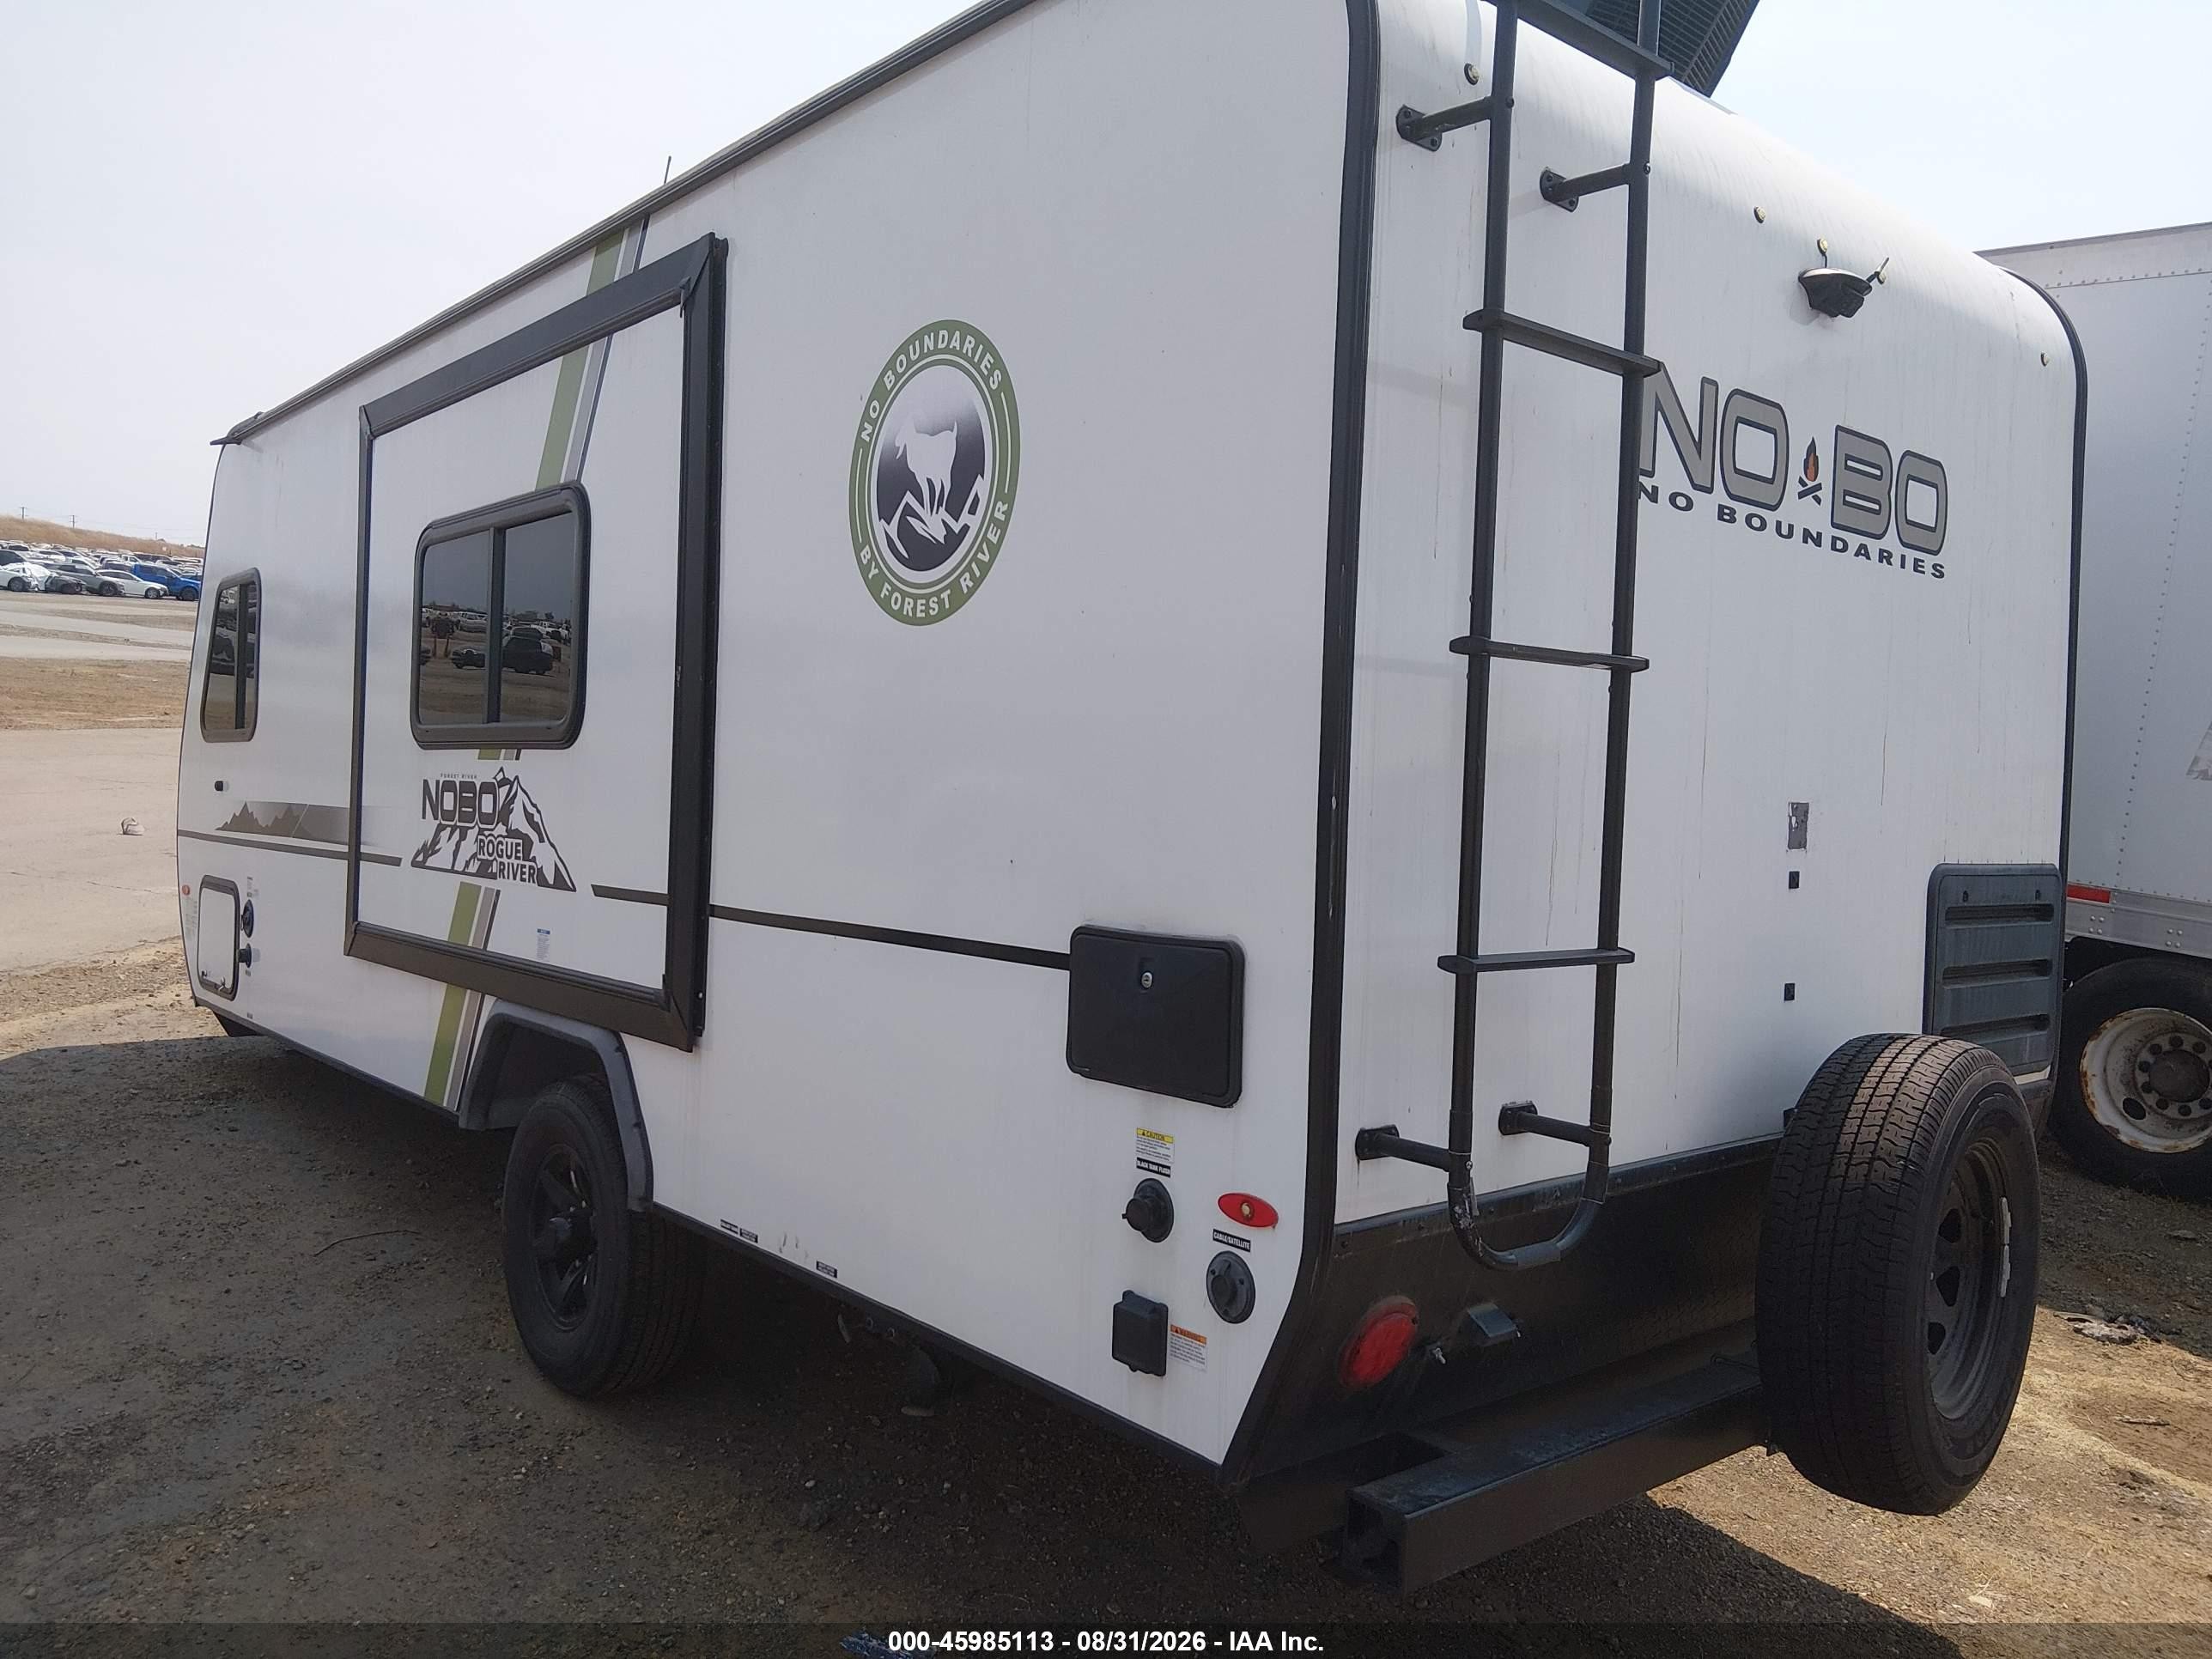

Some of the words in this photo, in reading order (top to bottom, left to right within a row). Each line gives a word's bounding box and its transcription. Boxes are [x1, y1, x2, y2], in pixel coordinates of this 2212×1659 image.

[860, 399, 880, 442] NO
[884, 330, 1002, 391] BOUNDARIES
[1639, 361, 1789, 512] NO
[1831, 424, 1948, 556] BO
[860, 550, 879, 581] BY
[880, 580, 952, 618] FOREST
[960, 500, 1008, 595] RIVER
[1638, 481, 1693, 512] NO
[1717, 503, 1946, 579] BOUNDARIES
[422, 779, 498, 825] NOBO
[478, 837, 522, 860] ROGUE
[498, 861, 537, 884] RIVER
